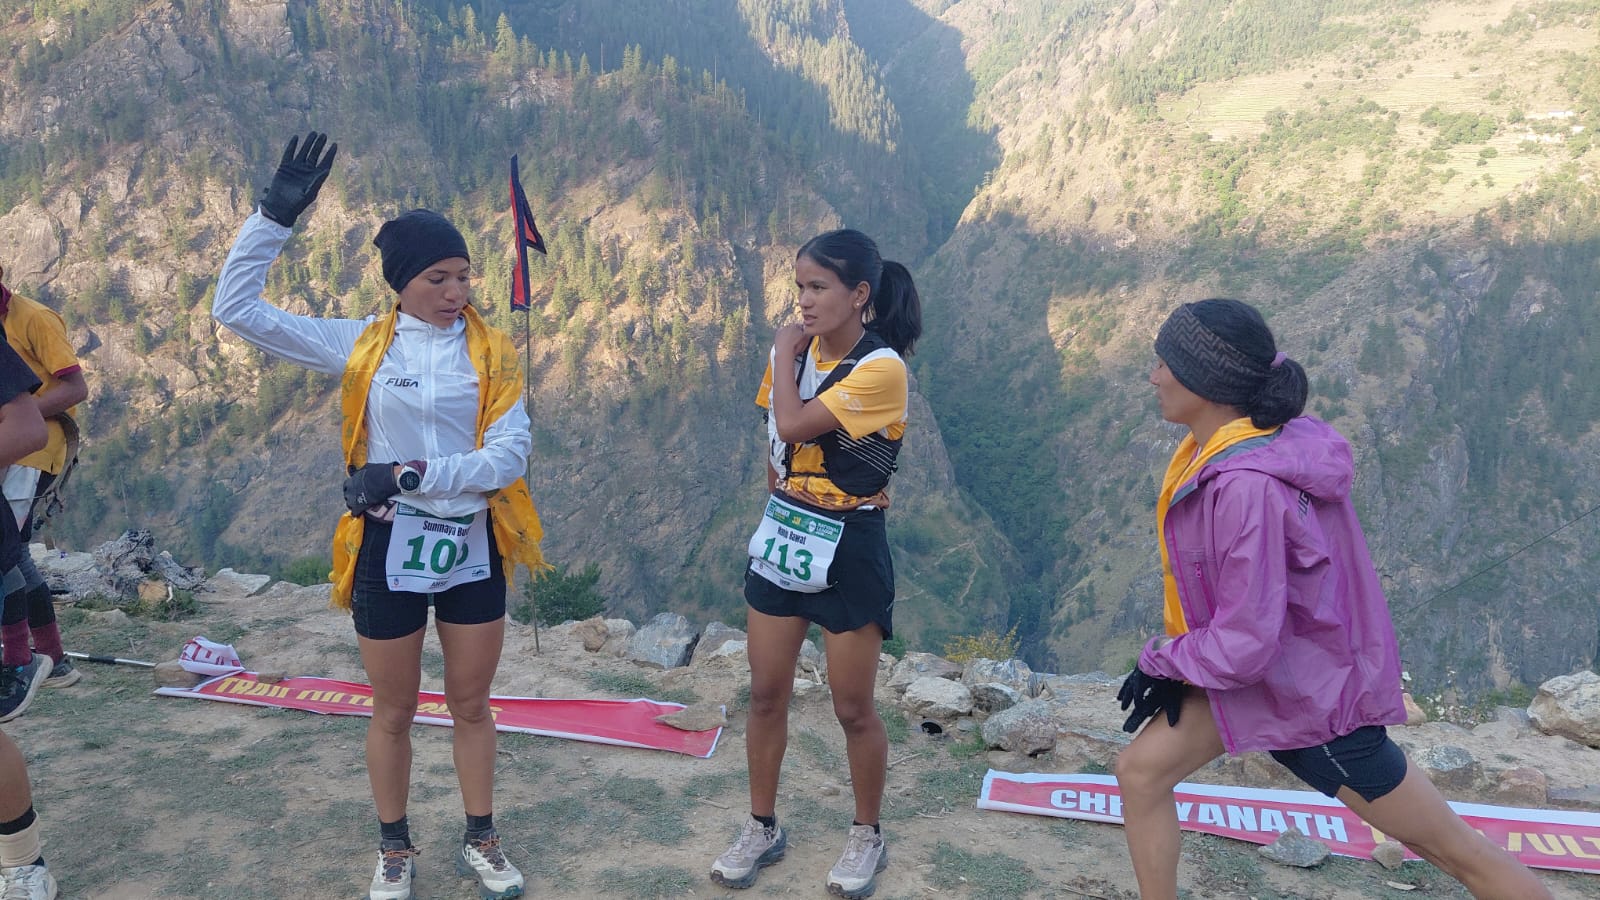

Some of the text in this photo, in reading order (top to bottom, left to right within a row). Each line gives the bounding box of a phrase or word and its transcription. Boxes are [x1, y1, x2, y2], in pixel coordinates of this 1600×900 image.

[385, 377, 419, 388] FUGA
[422, 520, 457, 536] Sunmaya
[762, 537, 814, 582] 113
[1050, 789, 1349, 843] CHYANATH
